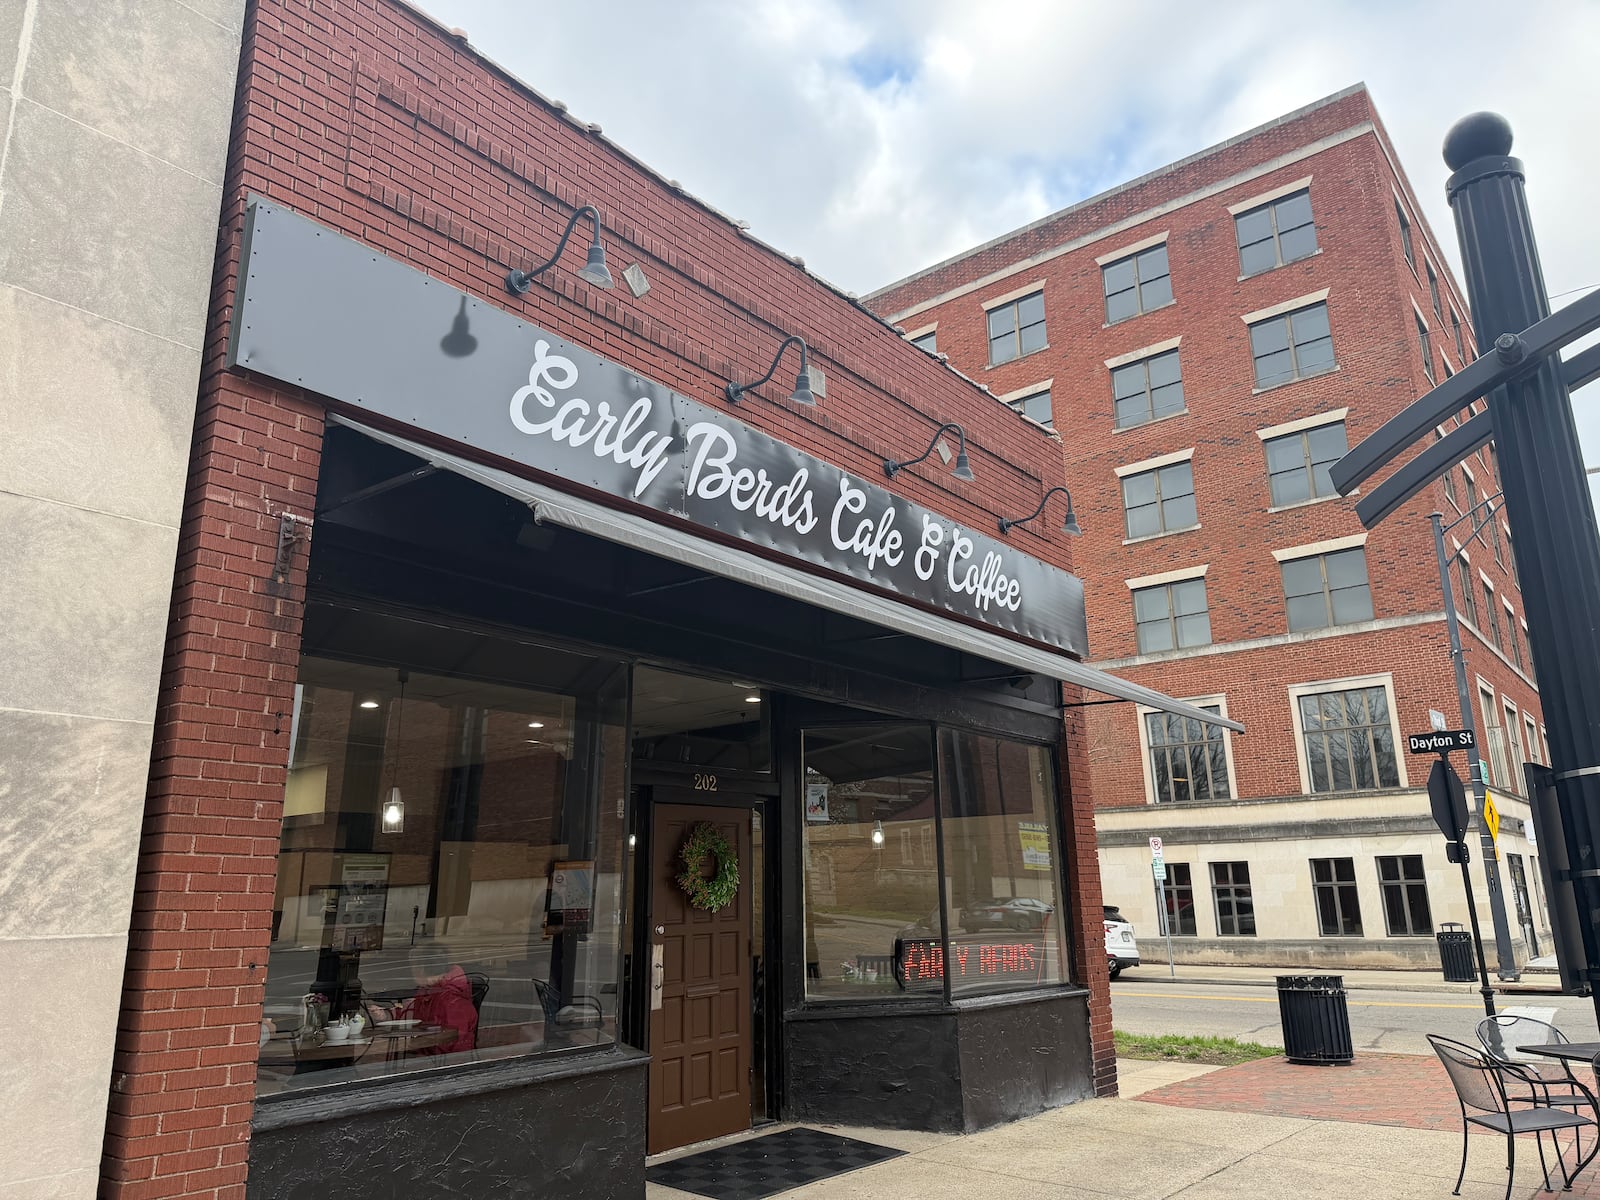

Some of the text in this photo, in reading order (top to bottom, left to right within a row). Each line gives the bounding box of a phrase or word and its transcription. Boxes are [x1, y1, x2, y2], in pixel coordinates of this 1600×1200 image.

[509, 339, 1021, 612] Early Berds Cafe & Coffee
[1410, 732, 1473, 750] Dayton St
[694, 773, 718, 792] 202
